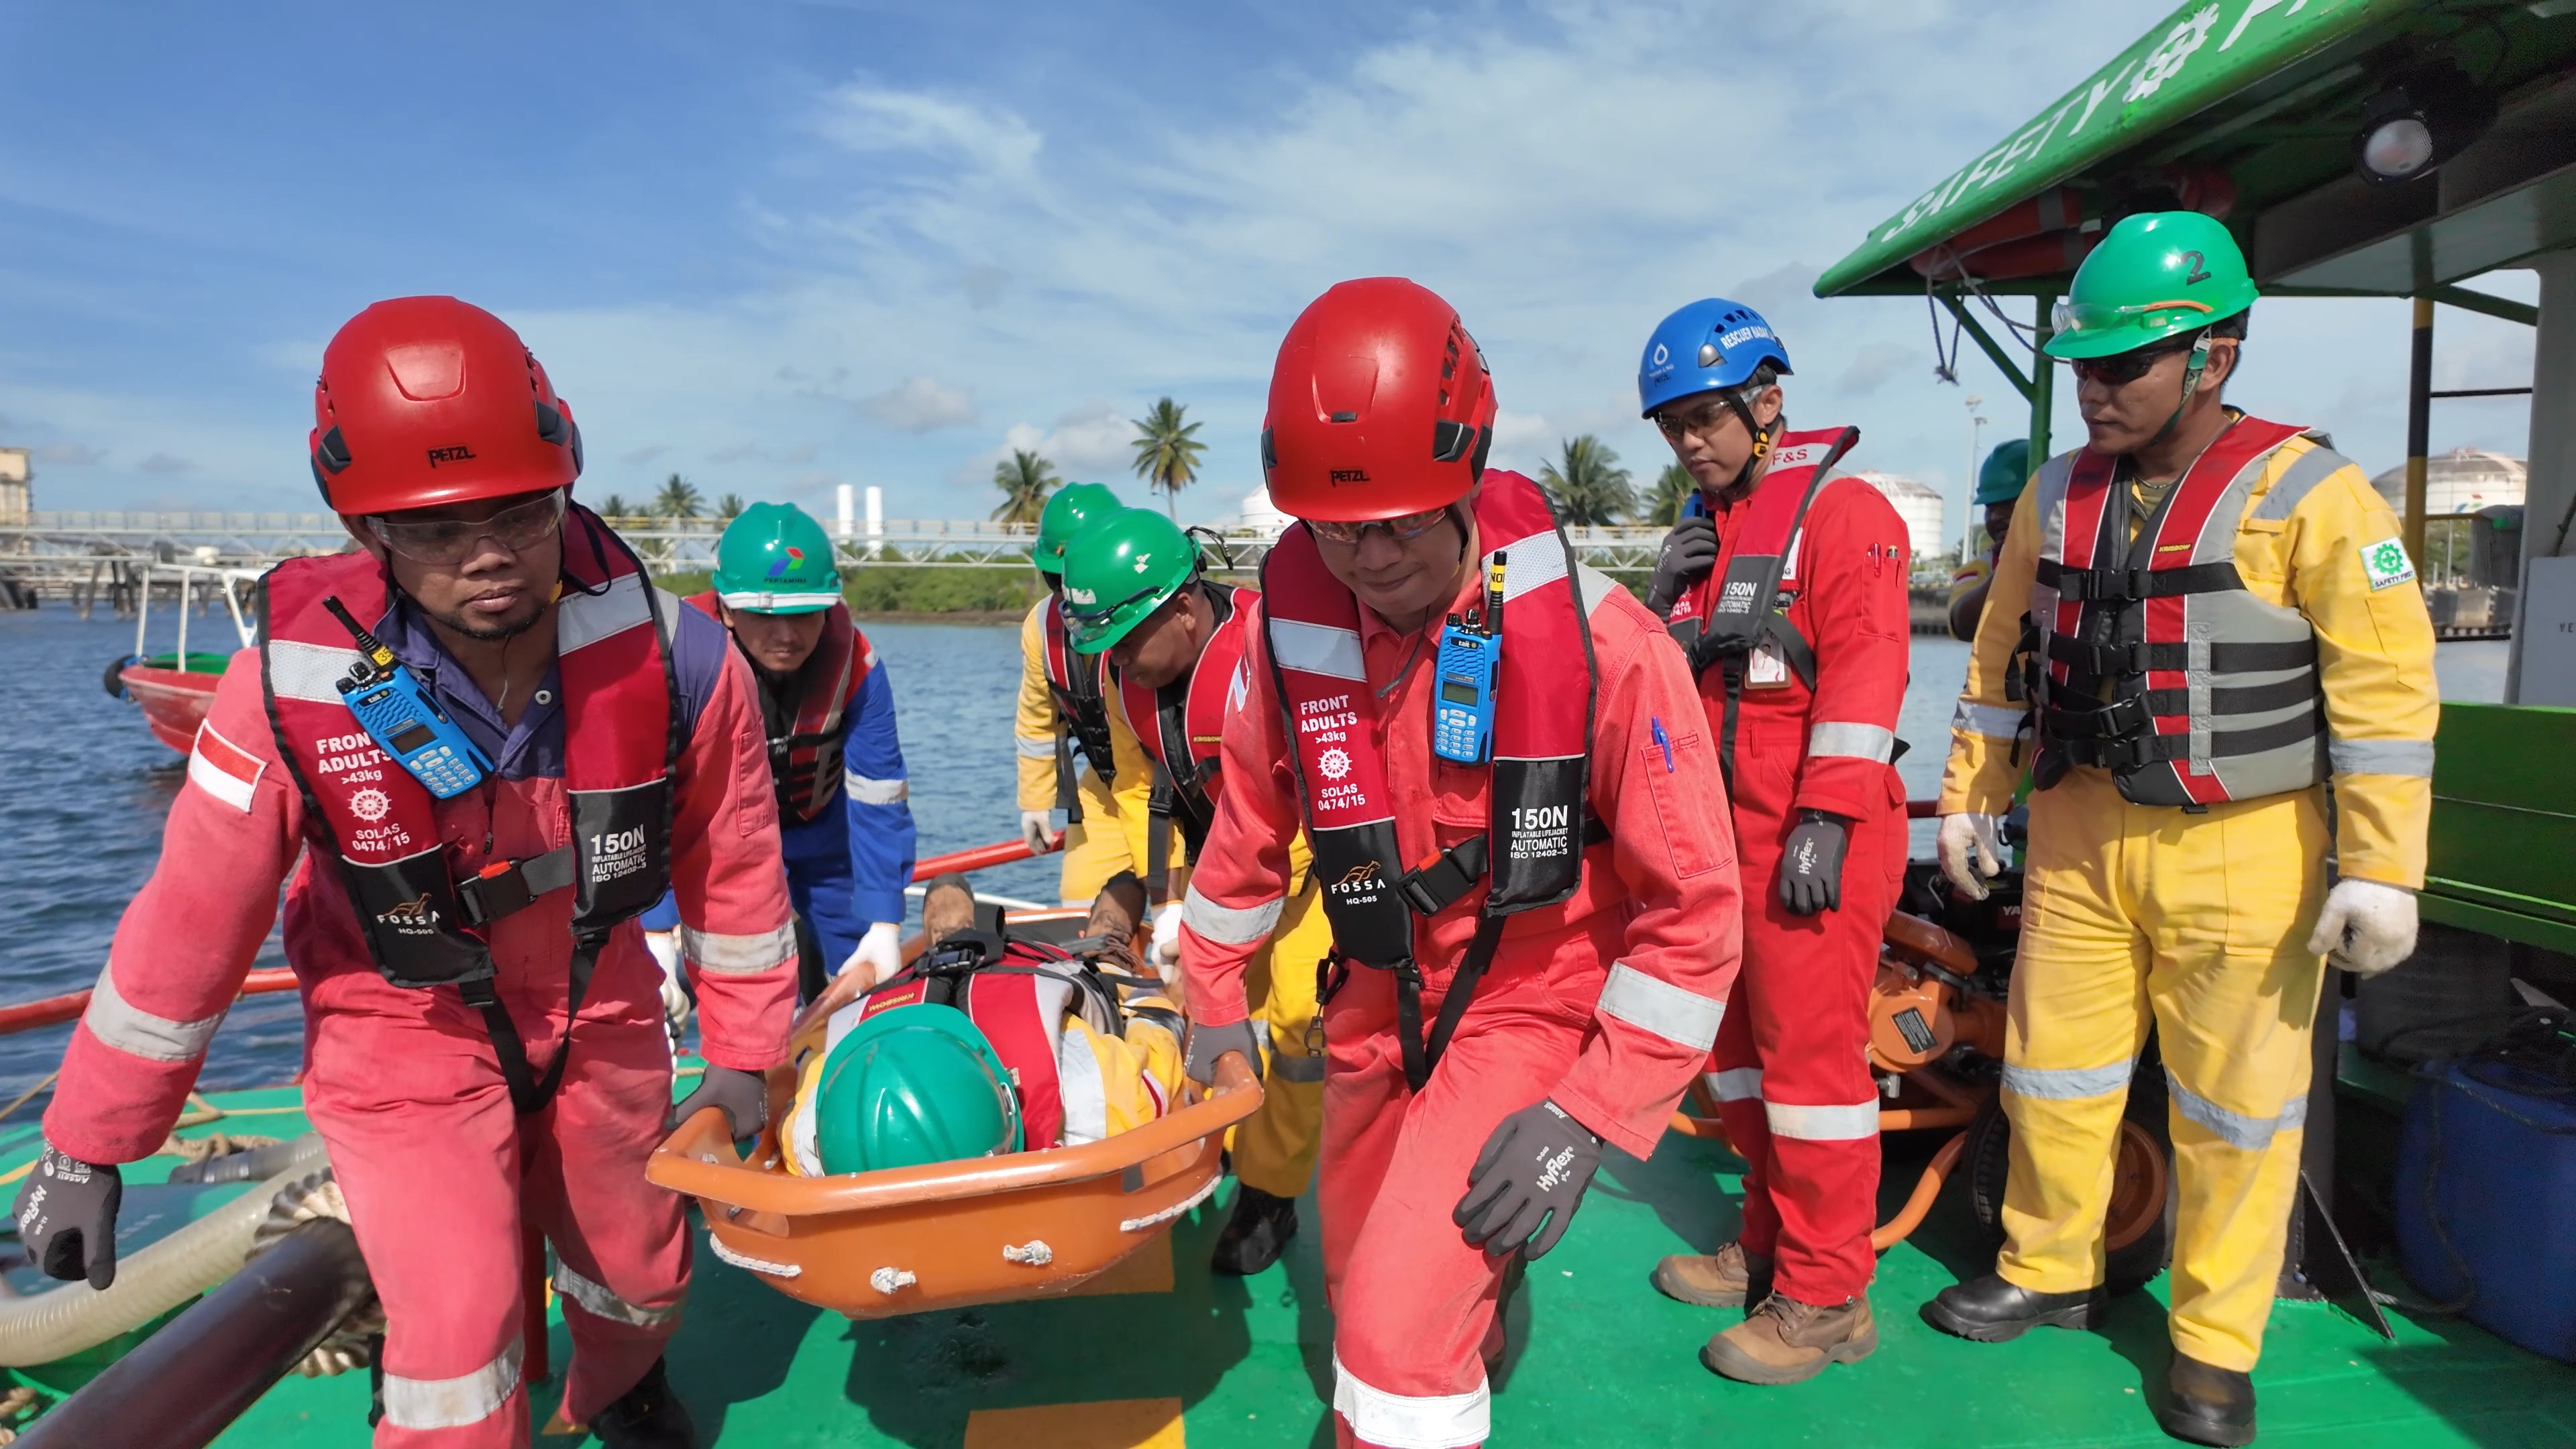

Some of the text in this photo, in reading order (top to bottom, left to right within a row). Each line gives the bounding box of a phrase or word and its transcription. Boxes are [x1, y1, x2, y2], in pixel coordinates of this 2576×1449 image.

[1881, 59, 2137, 243] SAFETY
[2178, 250, 2211, 286] 2
[427, 446, 477, 468] PETZL
[1330, 470, 1371, 488] PETZL
[1725, 582, 1758, 596] 150N
[2375, 575, 2401, 587] SAFETY
[378, 648, 391, 661] 35
[1300, 695, 1349, 715] FRONT
[1301, 712, 1358, 733] ADULTS
[316, 731, 372, 754] FRON
[1316, 731, 1346, 744] >43kg
[341, 769, 382, 784] >43kg
[1322, 784, 1358, 798] SOLAS
[1318, 794, 1366, 811] 0474/15
[1511, 805, 1568, 829] 150N
[356, 823, 400, 840] SOLAS
[590, 824, 645, 854] 150N
[1511, 830, 1542, 839] INFLATABLE
[352, 832, 410, 851] 0474/15
[1511, 836, 1568, 851] AUTOMATIC
[592, 852, 623, 863] INFLATABLE
[1531, 848, 1568, 858] 12402-3
[1799, 837, 1814, 875] HyFlex
[592, 851, 646, 875] AUTOMATIC
[592, 873, 611, 883] ISO
[1331, 878, 1386, 894] FOSSA
[1346, 896, 1377, 905] HQ-505
[1536, 1147, 1575, 1192] HyFlex
